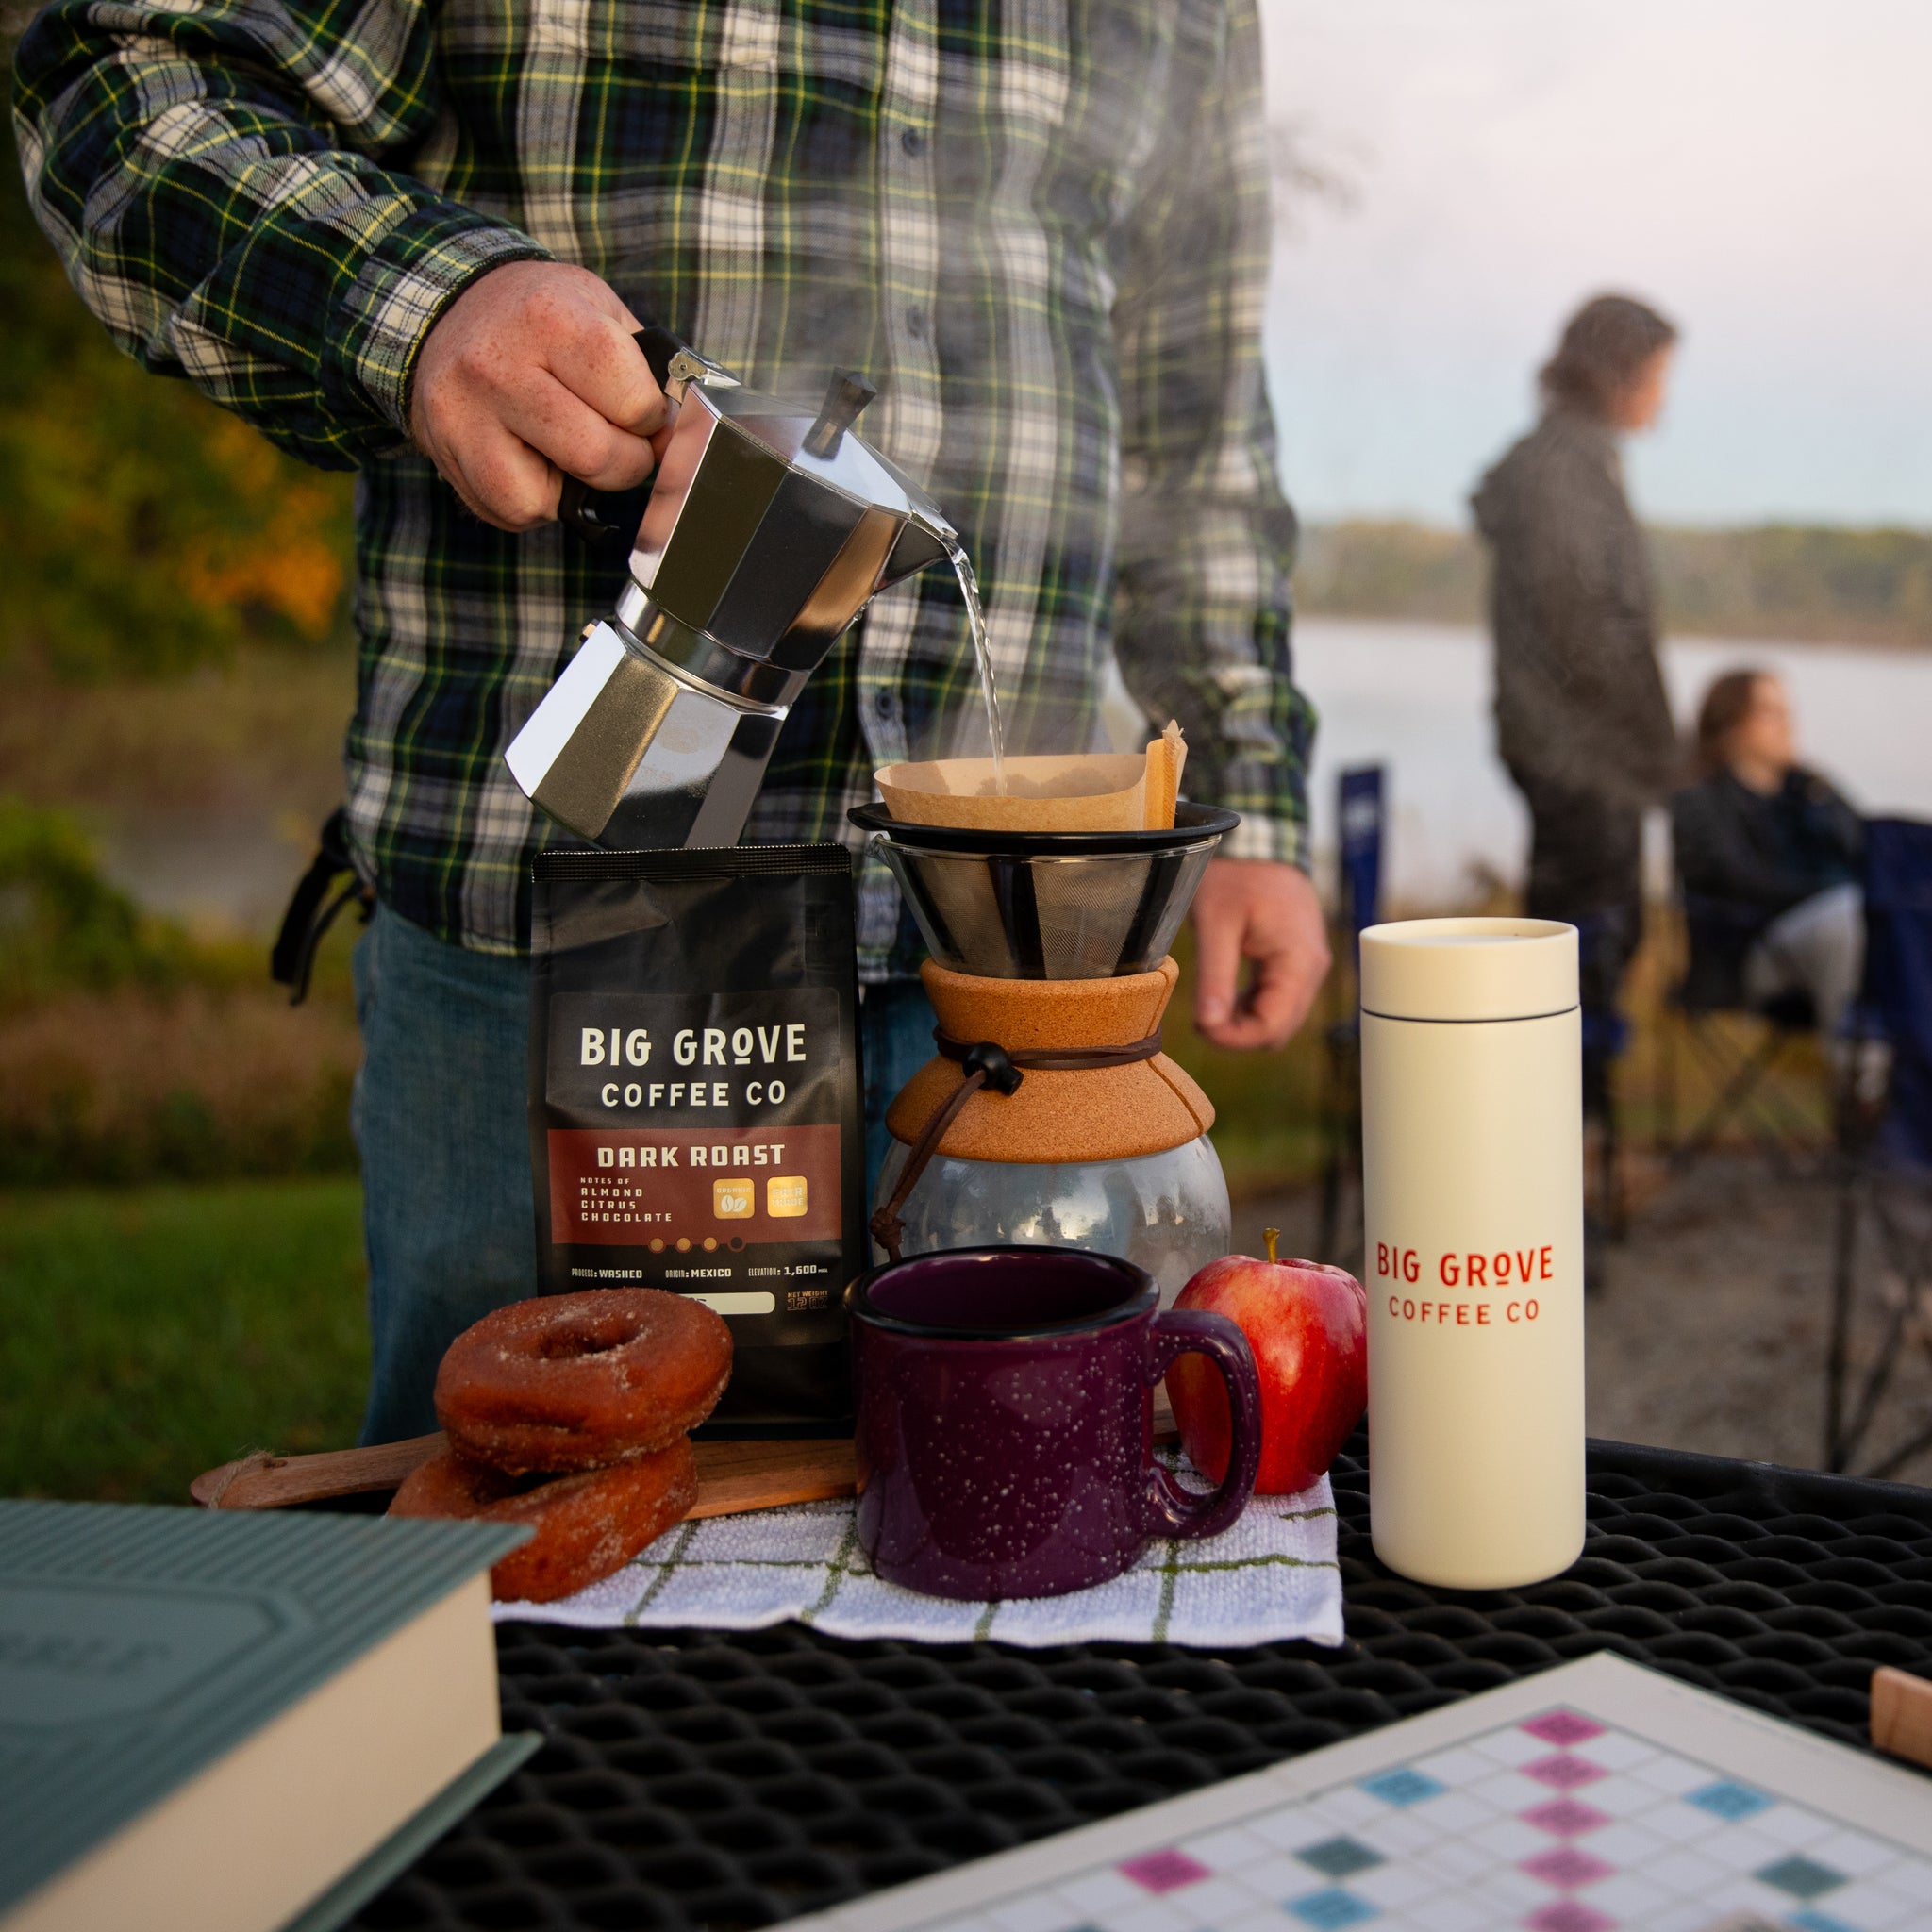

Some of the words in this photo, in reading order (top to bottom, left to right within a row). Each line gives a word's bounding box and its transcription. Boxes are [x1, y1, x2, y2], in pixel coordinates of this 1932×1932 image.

[580, 1027, 652, 1066] BIG
[673, 1024, 807, 1066] GROVE
[601, 1082, 729, 1107] COFFEE
[746, 1080, 786, 1105] CO
[597, 1146, 679, 1168] DARK
[690, 1144, 785, 1166] ROAST
[580, 1188, 642, 1197] ALMOND
[773, 1187, 803, 1196] FAIR
[581, 1200, 636, 1209] CITRUS
[581, 1212, 672, 1222] CHOCOLATE
[748, 1267, 781, 1276] ELEVATION:
[784, 1264, 817, 1276] 1,600
[1377, 1241, 1421, 1283] BIG
[1440, 1244, 1553, 1287] GROVE
[571, 1268, 597, 1278] PROCESS:
[599, 1269, 643, 1278] WASHED
[665, 1269, 689, 1278] ORIGIN:
[691, 1268, 732, 1278] MEXICO
[787, 1297, 808, 1311] 12
[1389, 1295, 1491, 1324] COFFEE
[1507, 1299, 1539, 1323] CO
